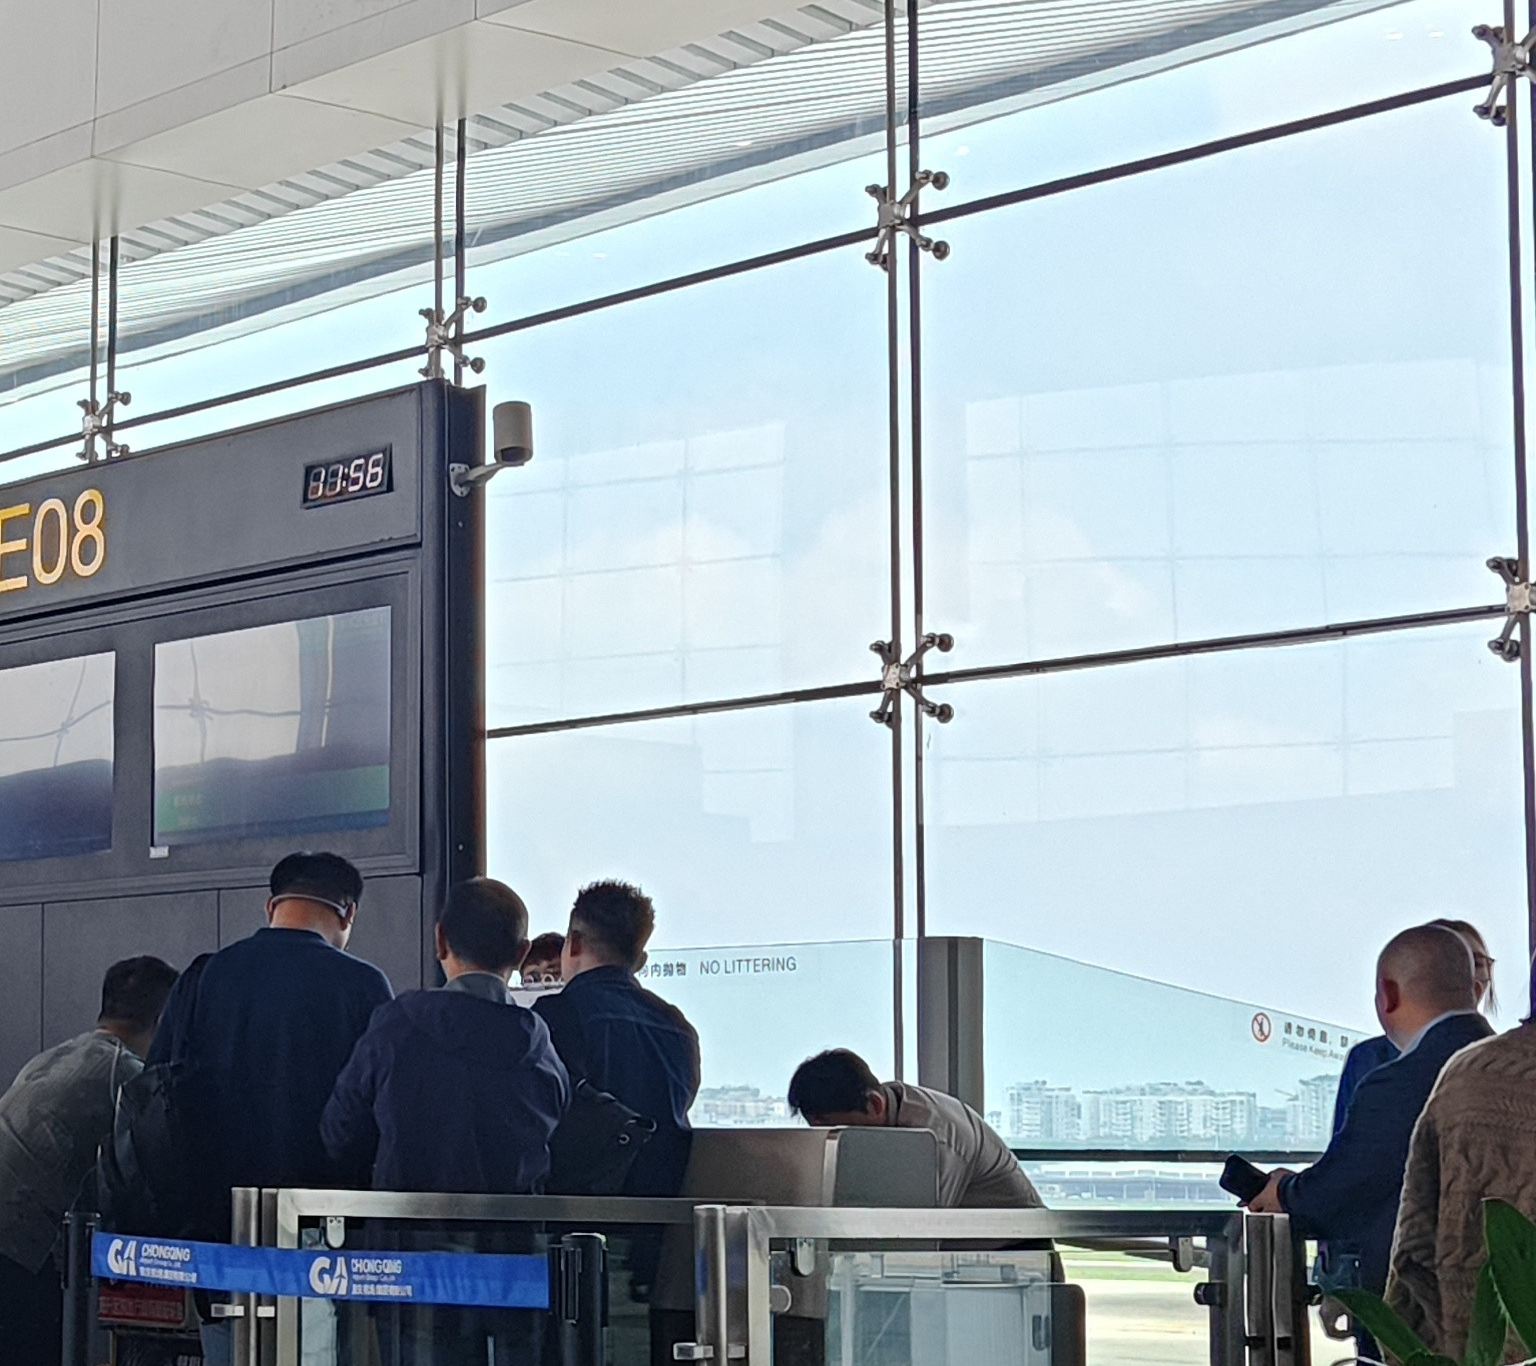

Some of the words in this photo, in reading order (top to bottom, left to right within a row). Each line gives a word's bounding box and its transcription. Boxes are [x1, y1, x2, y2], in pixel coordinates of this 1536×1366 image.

[308, 451, 385, 500] 11:56
[700, 960, 720, 975] NO
[724, 956, 797, 974] LITTERING
[141, 1243, 191, 1262] CHONGQING
[351, 1258, 402, 1274] CHONGQING
